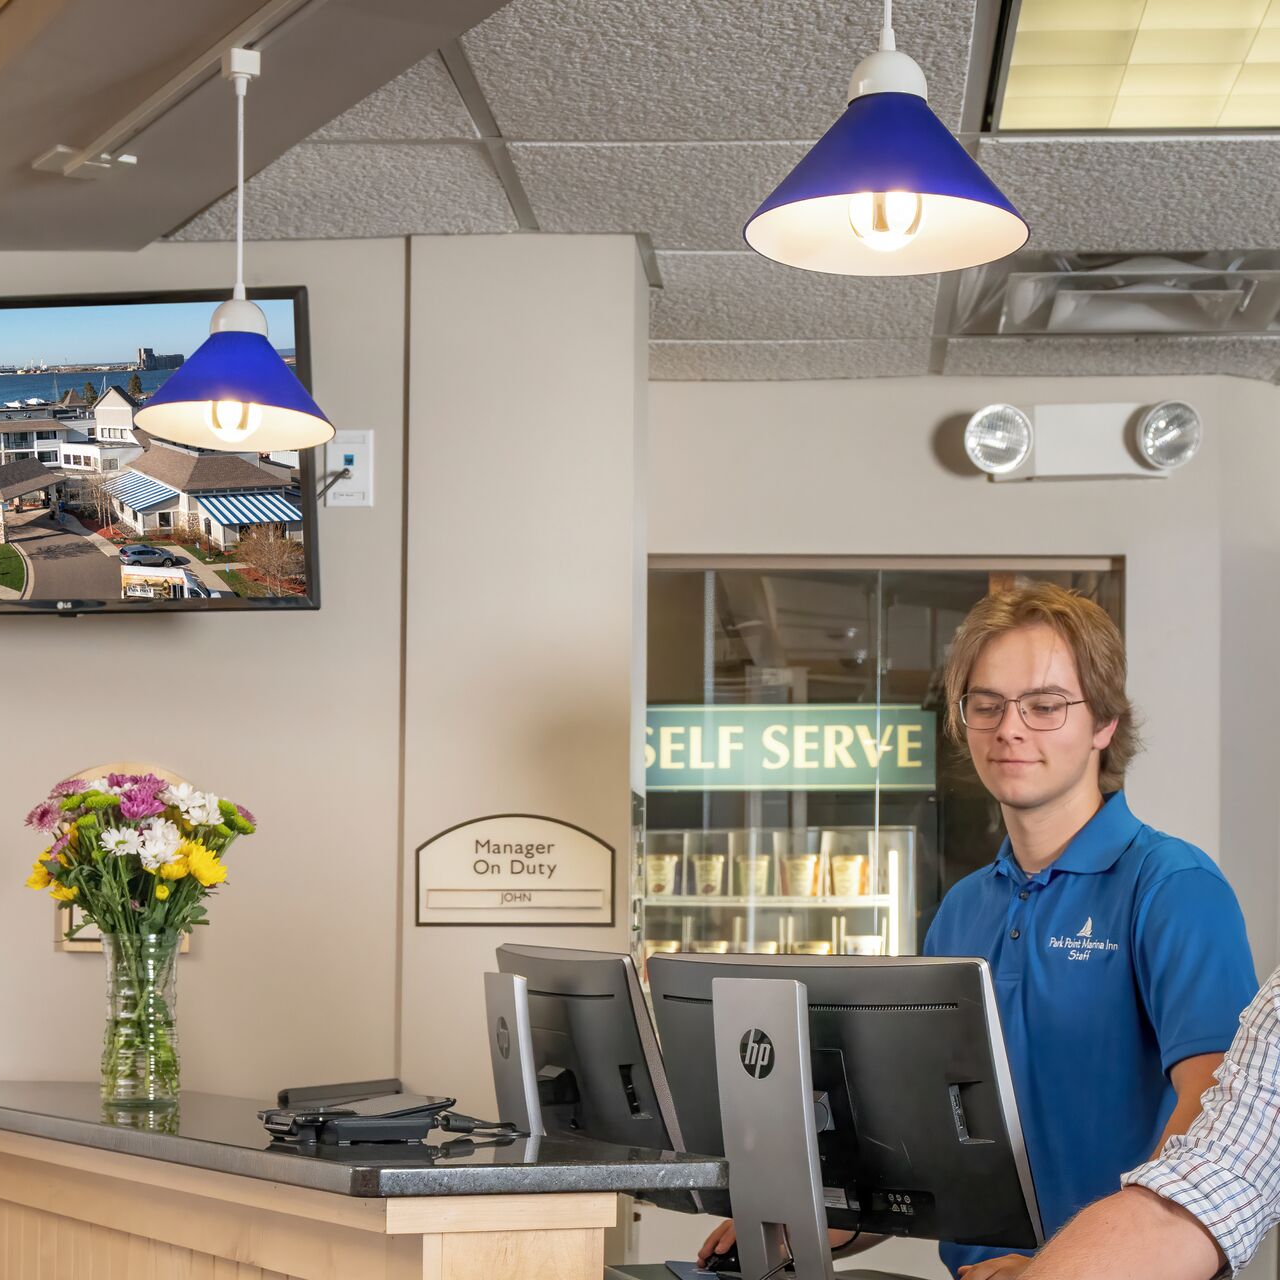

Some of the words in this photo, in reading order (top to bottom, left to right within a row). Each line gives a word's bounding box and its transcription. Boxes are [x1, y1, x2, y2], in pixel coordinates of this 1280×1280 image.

[761, 725, 923, 769] SERVE
[475, 839, 555, 859] Manager
[473, 859, 501, 875] On
[510, 859, 557, 879] Duty
[500, 892, 532, 905] JOHN
[1049, 936, 1064, 948] Park
[1064, 938, 1082, 949] Point
[1082, 938, 1105, 950] Marina
[1106, 939, 1119, 951] Inn
[1067, 949, 1091, 961] Staff
[742, 1028, 773, 1080] hp
